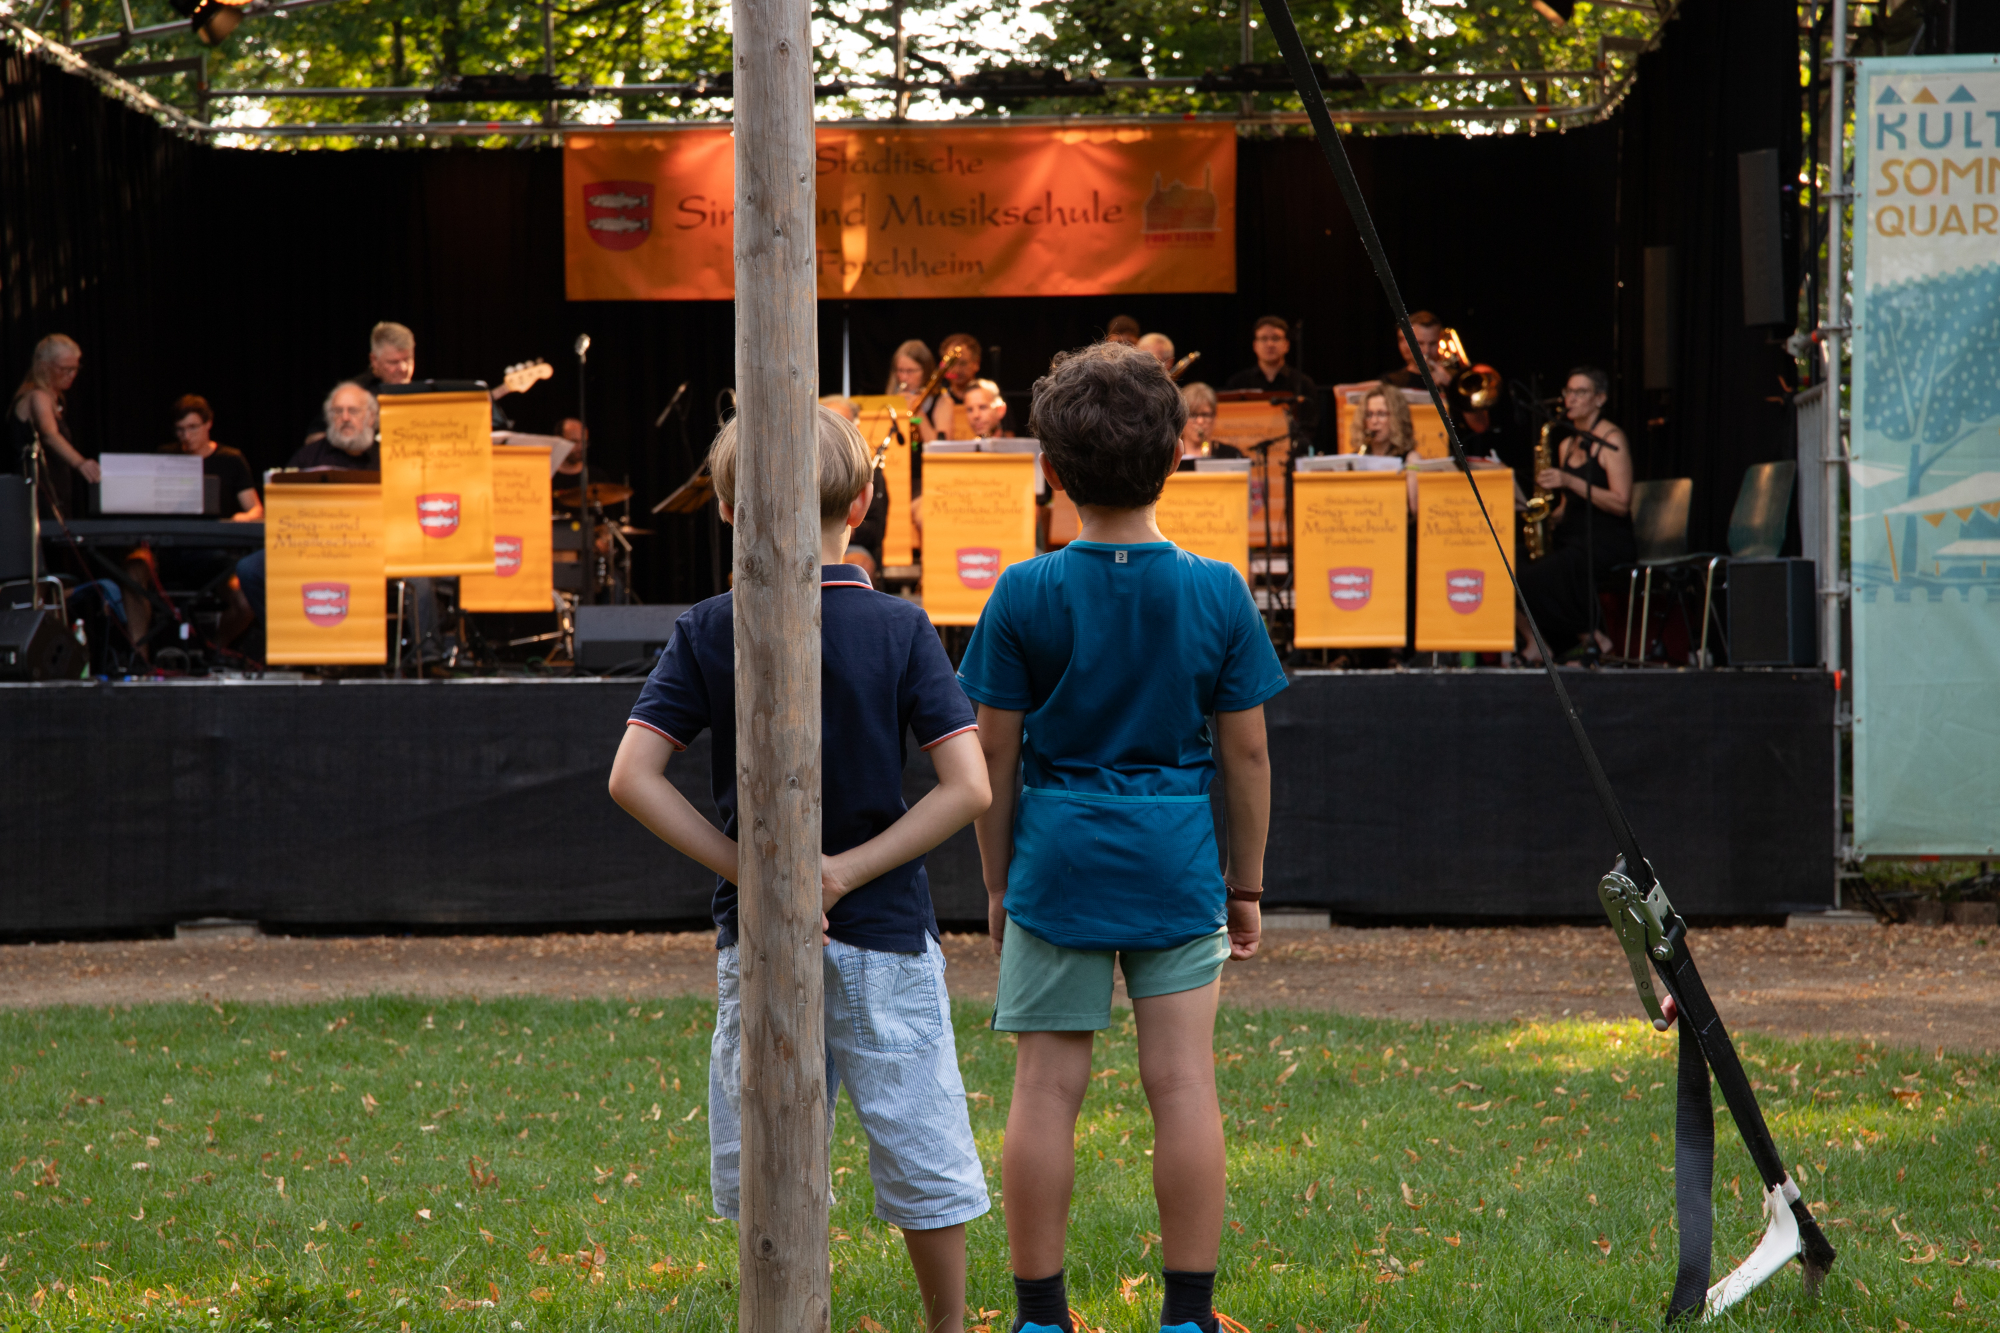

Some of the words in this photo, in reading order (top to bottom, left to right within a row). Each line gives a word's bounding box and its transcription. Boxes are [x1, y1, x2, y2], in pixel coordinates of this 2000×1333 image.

[815, 146, 983, 176] Städtische
[1876, 157, 2000, 197] SOM
[674, 195, 735, 229] Sin
[816, 192, 866, 227] nd
[879, 190, 1125, 231] Musikschule
[1876, 203, 1999, 238] QUAR
[817, 247, 985, 278] Forchheim
